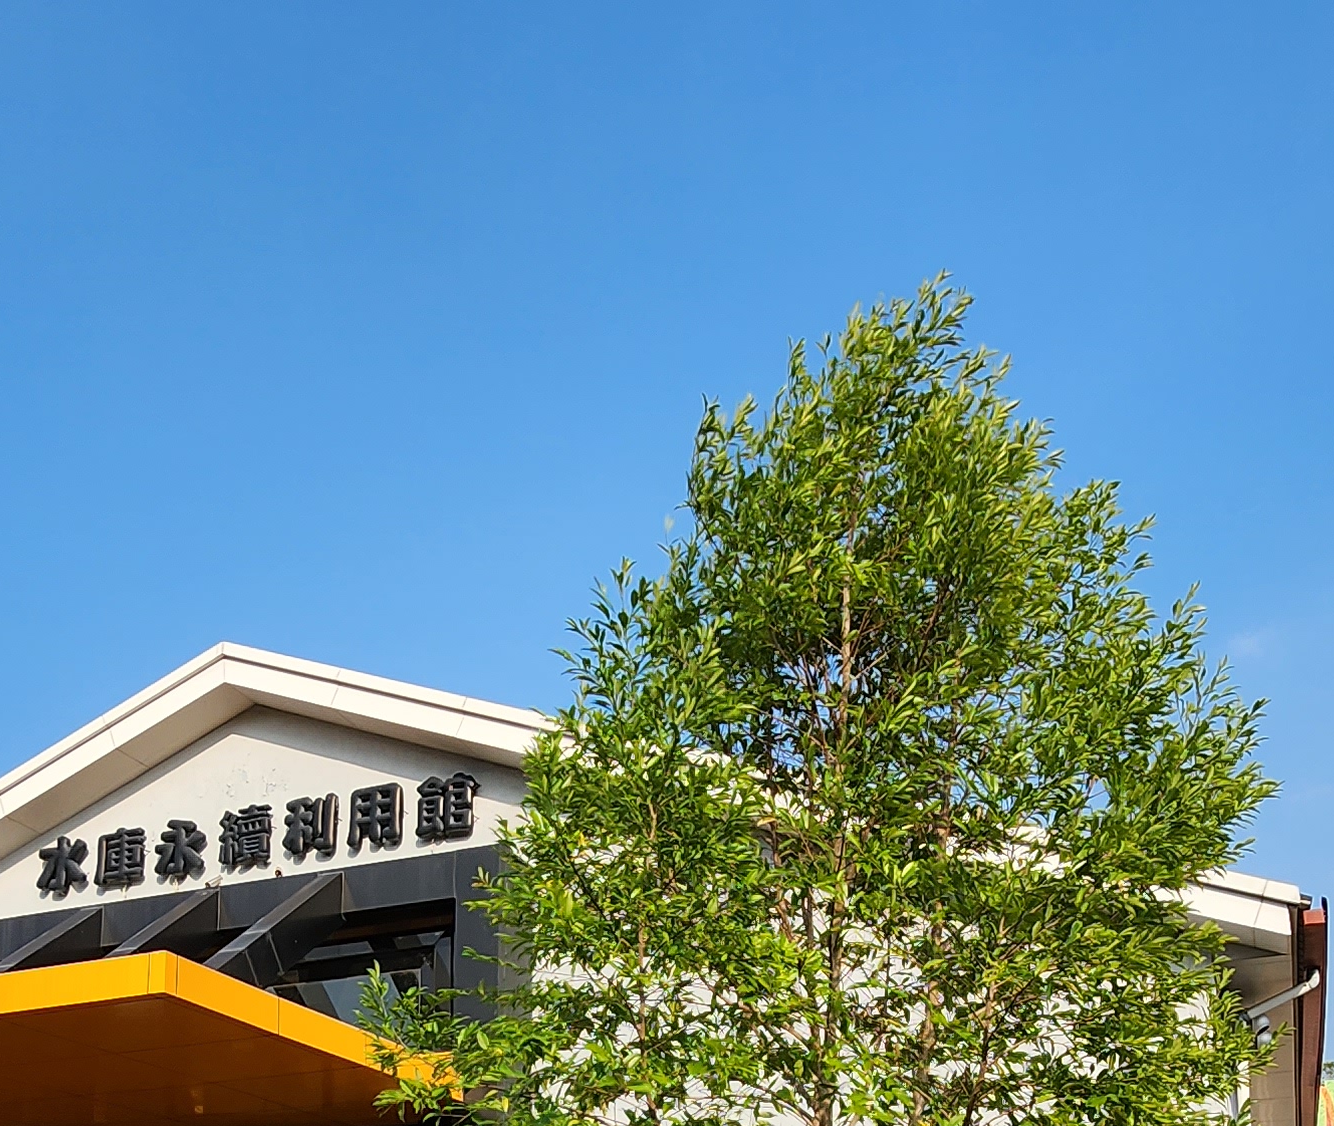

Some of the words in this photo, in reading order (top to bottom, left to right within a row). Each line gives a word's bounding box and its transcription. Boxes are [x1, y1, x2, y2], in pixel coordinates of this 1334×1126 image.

[37, 772, 480, 894] 水庫永續利用館
